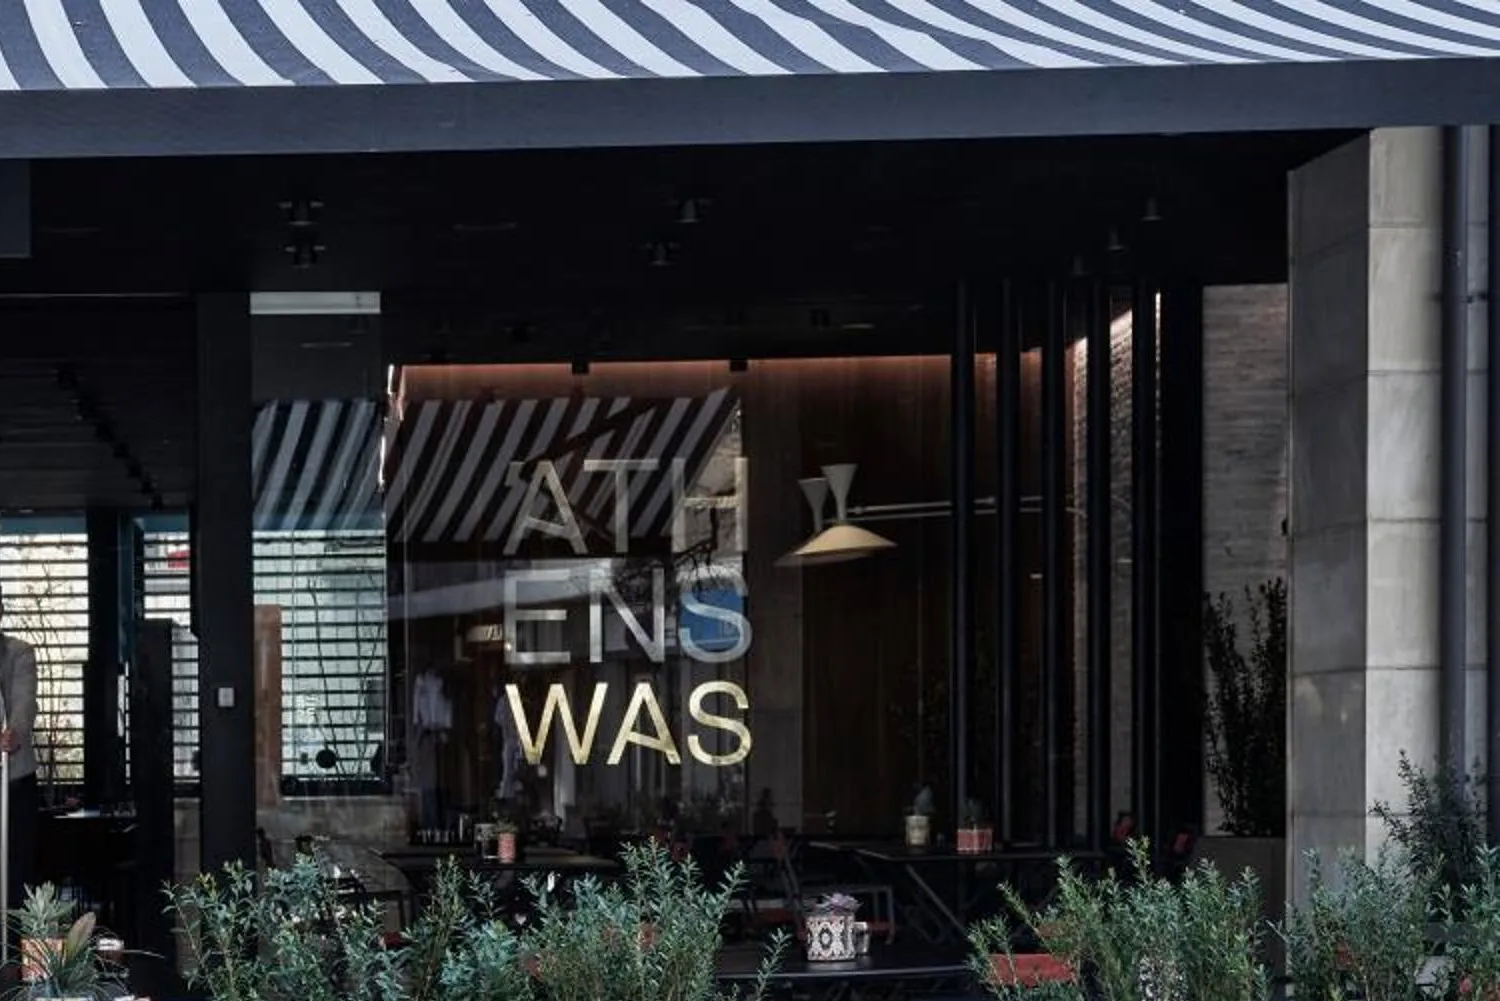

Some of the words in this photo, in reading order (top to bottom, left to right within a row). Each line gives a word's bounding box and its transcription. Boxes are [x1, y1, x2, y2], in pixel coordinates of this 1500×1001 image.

[503, 457, 749, 554] ATH
[504, 564, 752, 663] ENS
[504, 680, 752, 767] WAS
